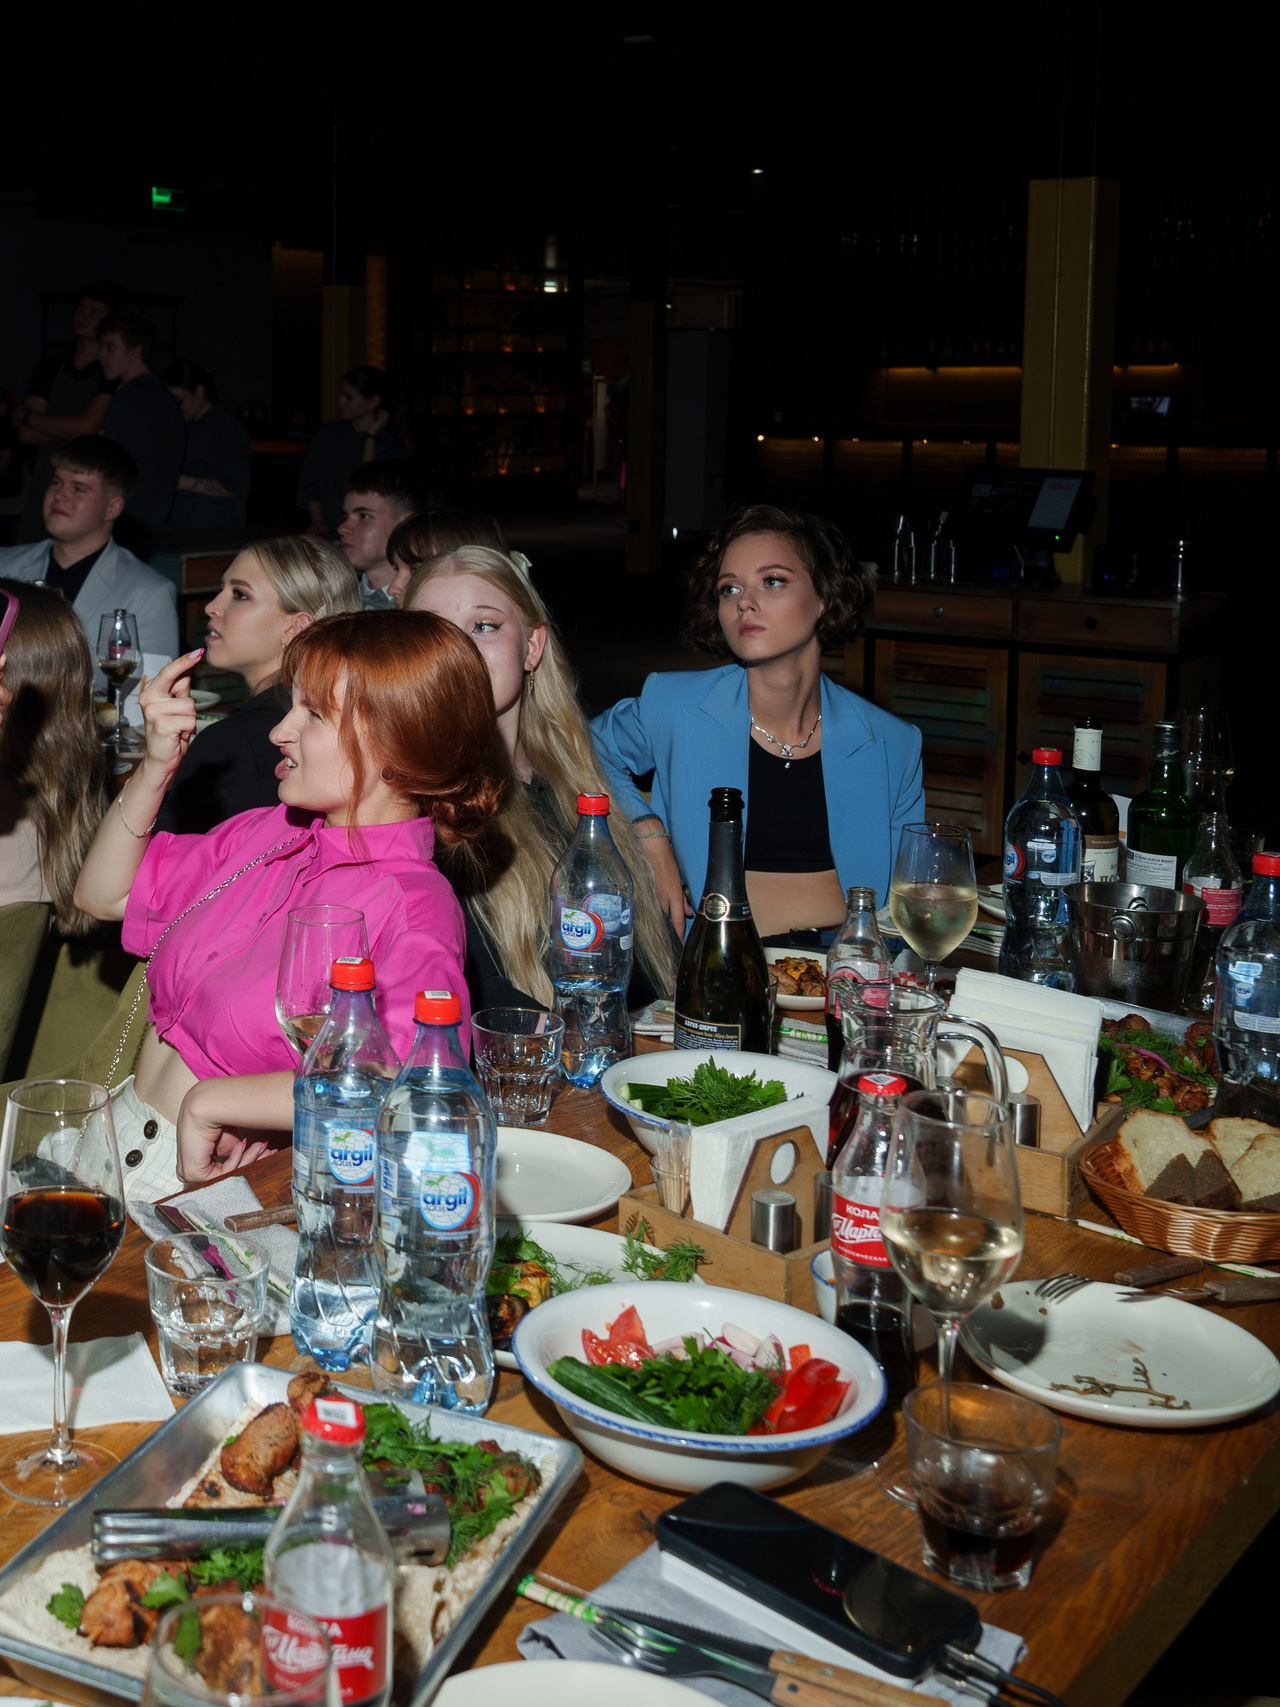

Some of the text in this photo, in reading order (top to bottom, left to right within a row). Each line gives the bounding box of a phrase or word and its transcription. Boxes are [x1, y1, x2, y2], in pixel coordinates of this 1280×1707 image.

[562, 921, 592, 938] argil
[330, 1143, 373, 1167] argil
[423, 1187, 467, 1211] argil
[845, 1204, 880, 1220] КОЛА
